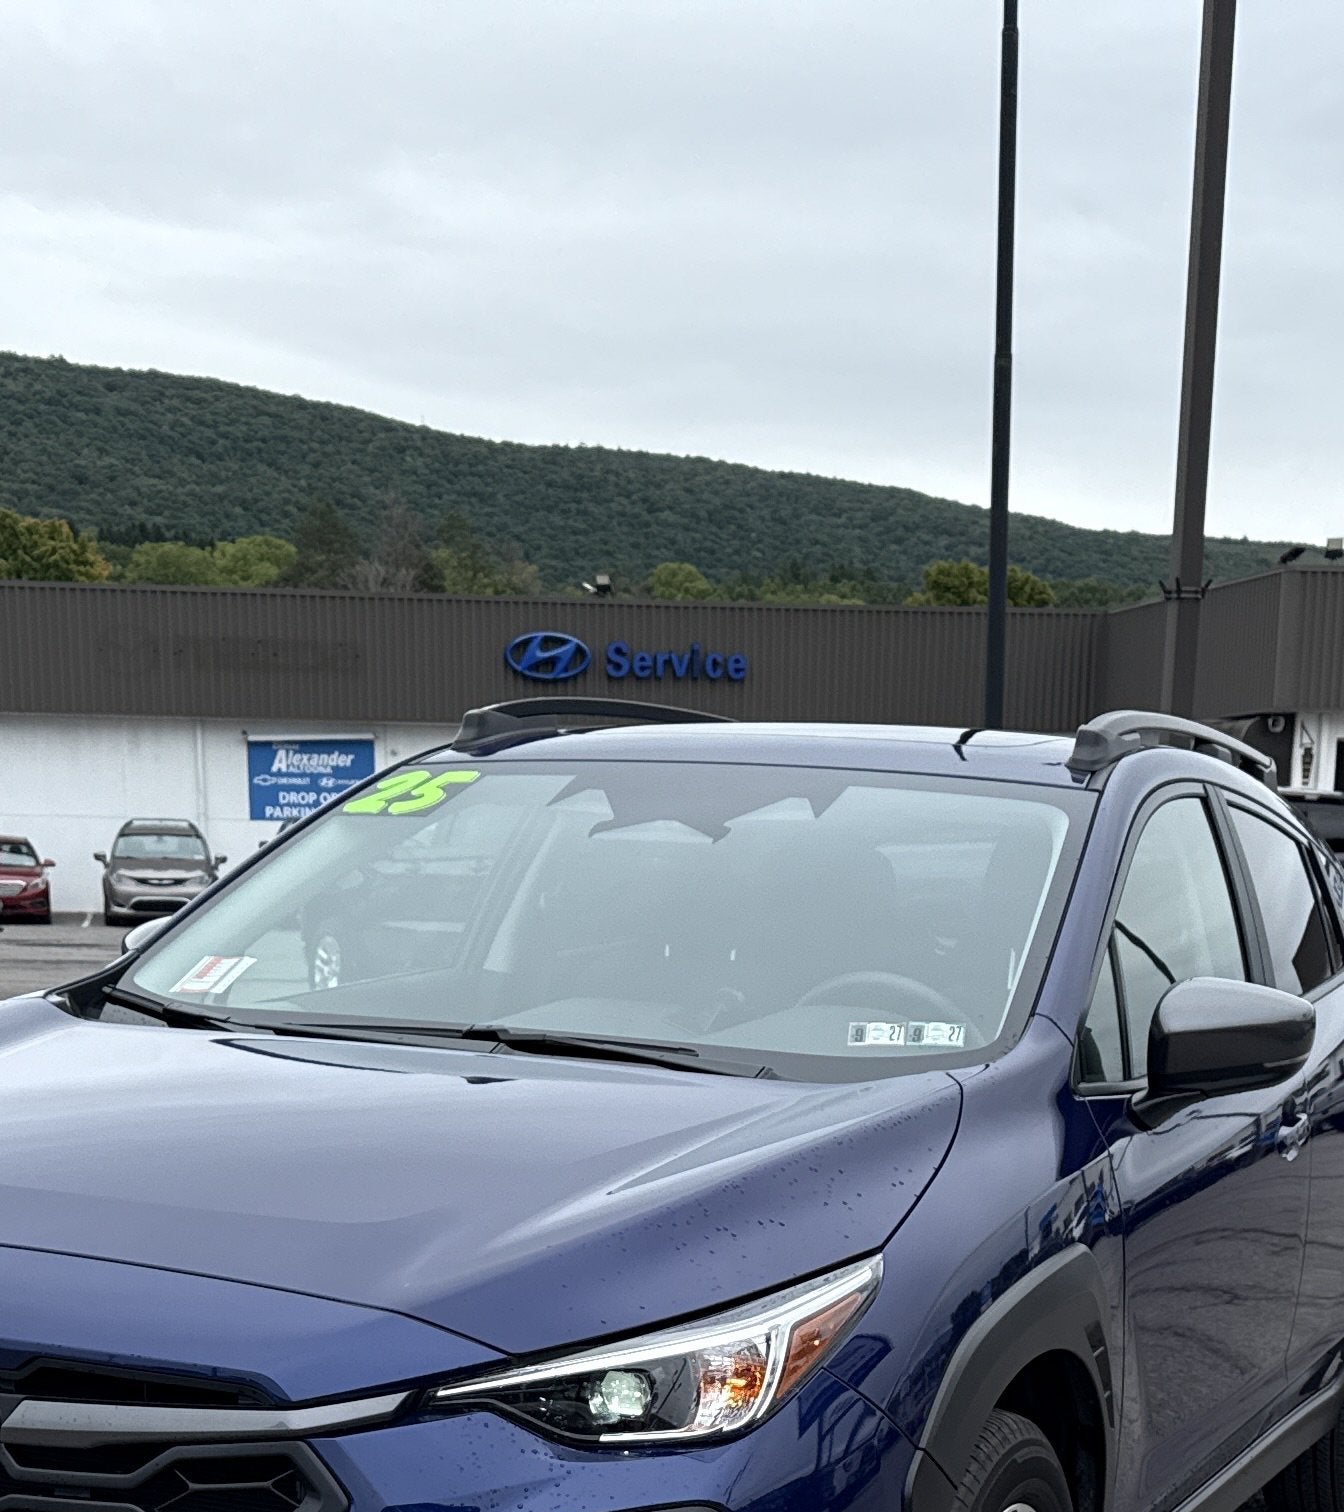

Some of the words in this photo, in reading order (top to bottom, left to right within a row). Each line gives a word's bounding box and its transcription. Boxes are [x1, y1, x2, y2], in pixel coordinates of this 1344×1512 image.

[606, 640, 748, 680] Service
[270, 749, 355, 773] Alexander
[278, 791, 318, 804] DROP
[342, 770, 482, 815] 25
[265, 805, 317, 818] PARKIN
